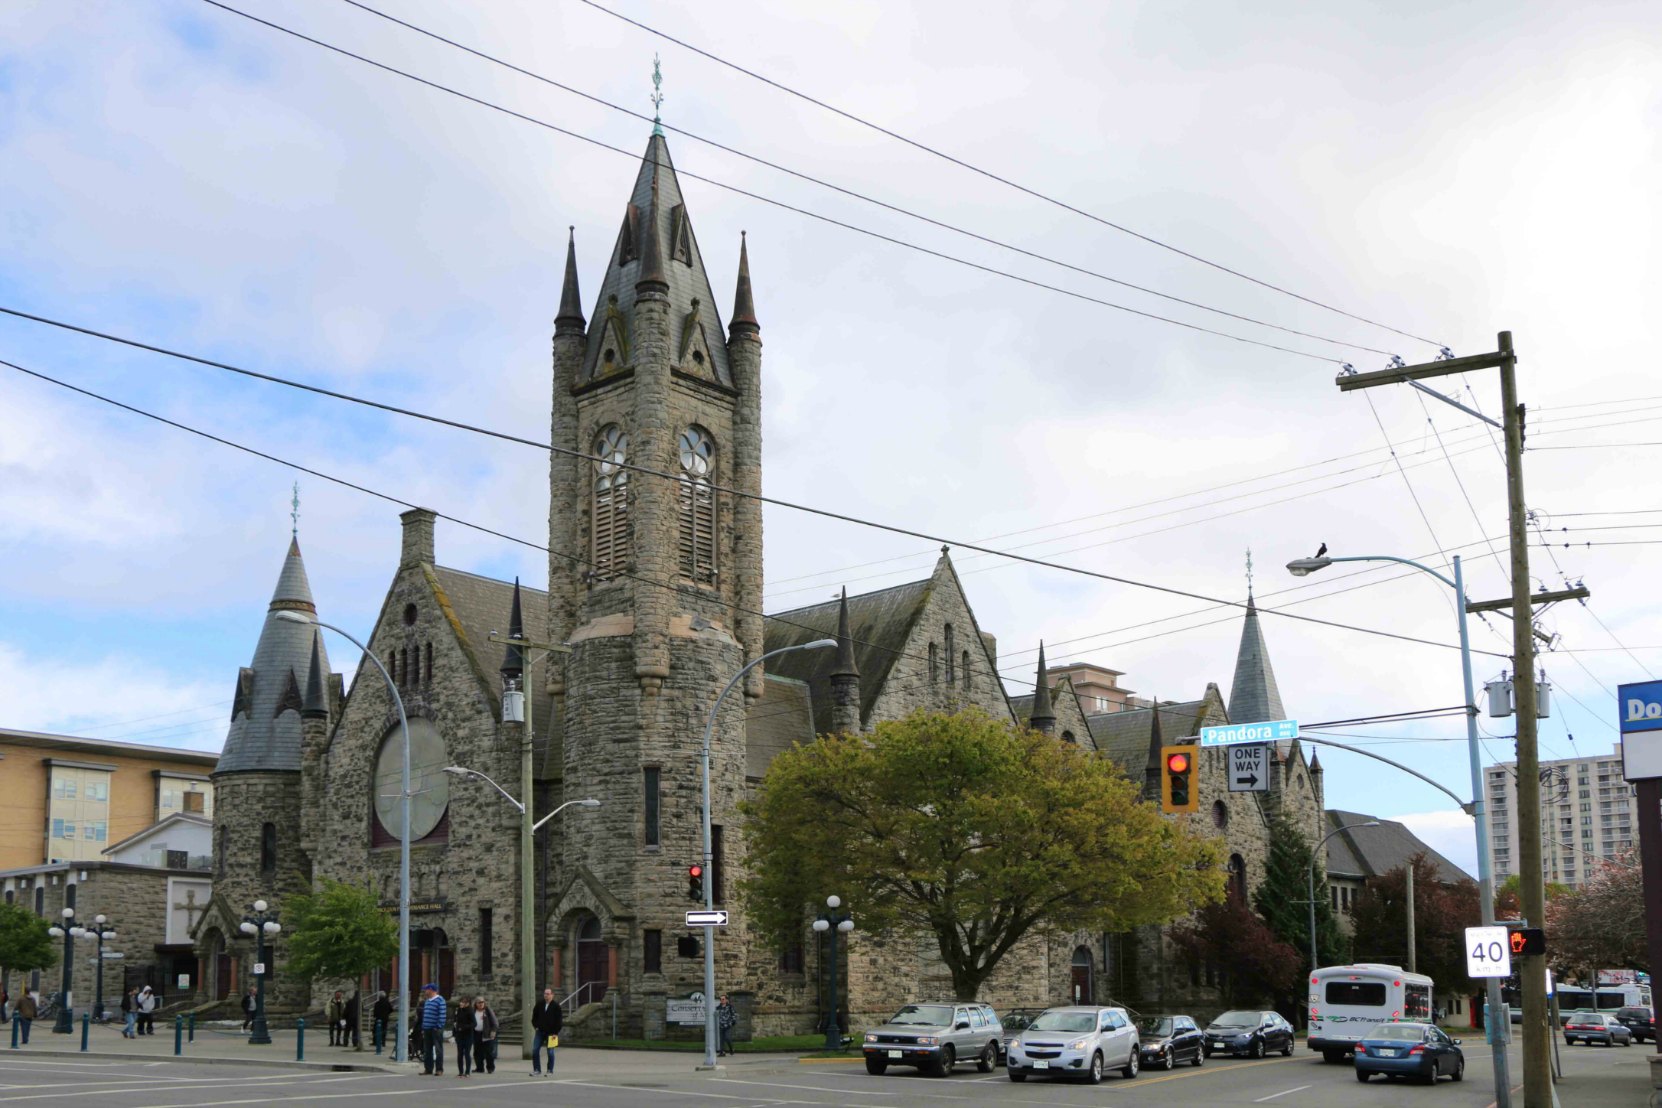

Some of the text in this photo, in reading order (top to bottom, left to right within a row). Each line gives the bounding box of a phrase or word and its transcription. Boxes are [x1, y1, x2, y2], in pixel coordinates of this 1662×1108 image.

[1208, 726, 1272, 742] Pandora
[1235, 749, 1261, 759] ONE
[1235, 762, 1260, 771] WAY
[1472, 942, 1503, 962] 40
